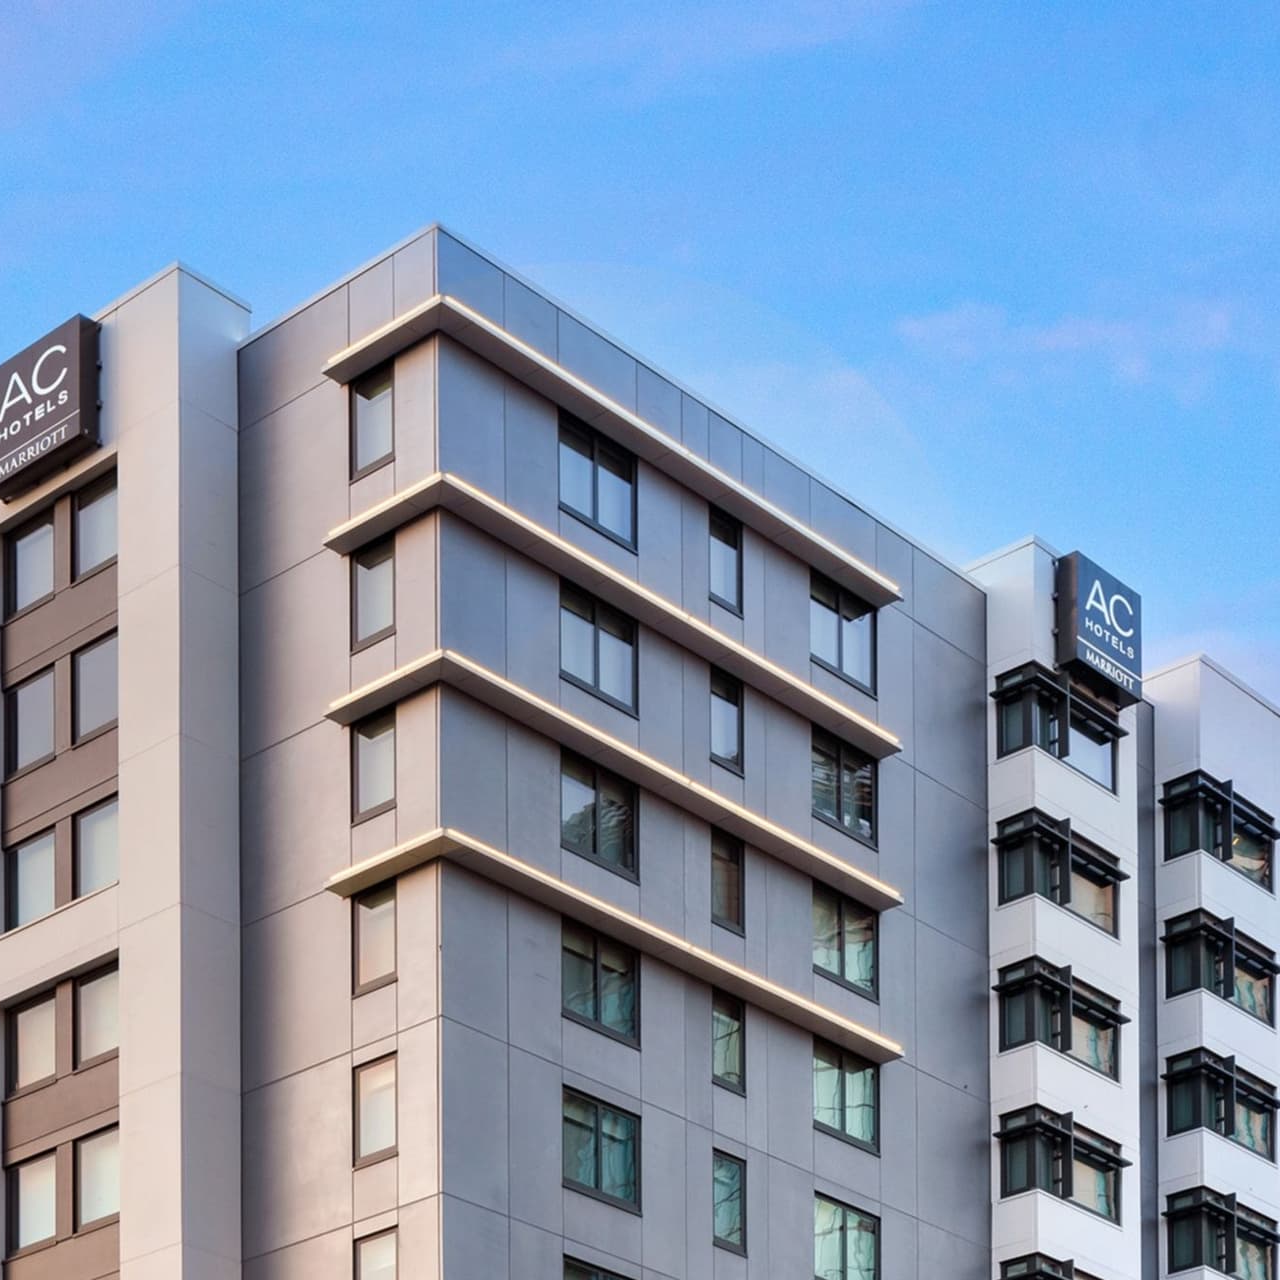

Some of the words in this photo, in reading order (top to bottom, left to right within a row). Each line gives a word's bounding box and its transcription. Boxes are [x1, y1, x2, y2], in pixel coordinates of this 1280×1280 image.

[1085, 579, 1134, 638] AC
[1084, 616, 1135, 660] HOTELS
[1086, 649, 1135, 690] MARRIOTT
